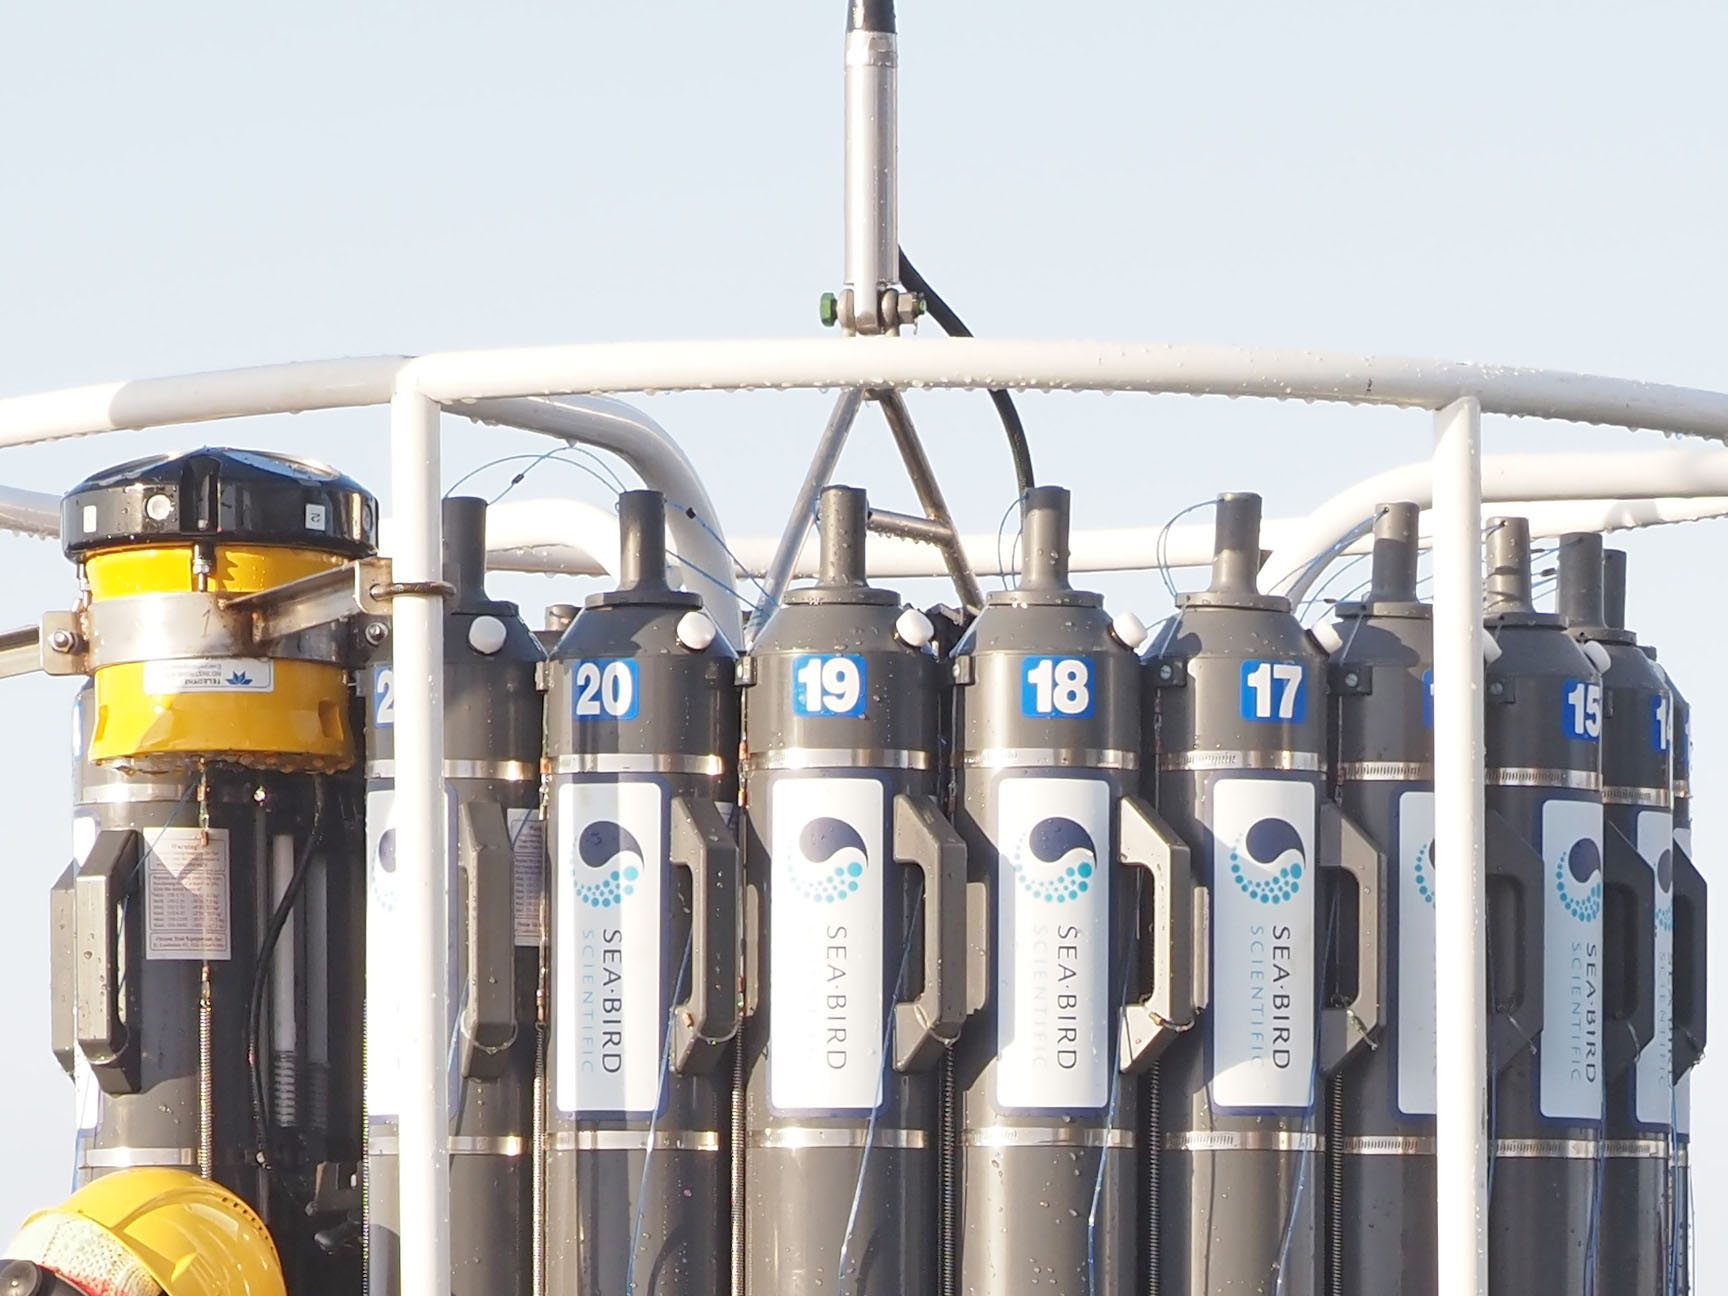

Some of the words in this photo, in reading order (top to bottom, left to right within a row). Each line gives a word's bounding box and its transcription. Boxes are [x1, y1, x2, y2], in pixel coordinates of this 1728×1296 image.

[376, 669, 395, 724] 2
[576, 661, 633, 716] 20
[798, 657, 860, 714] 19
[1027, 659, 1090, 714] 18
[1246, 663, 1303, 719] 17
[1568, 682, 1601, 738] 15
[582, 928, 594, 1073] SCIENTIFIC
[1249, 925, 1265, 1069] SCIENTIFIC
[1570, 942, 1582, 1081] SCIENTIFIC
